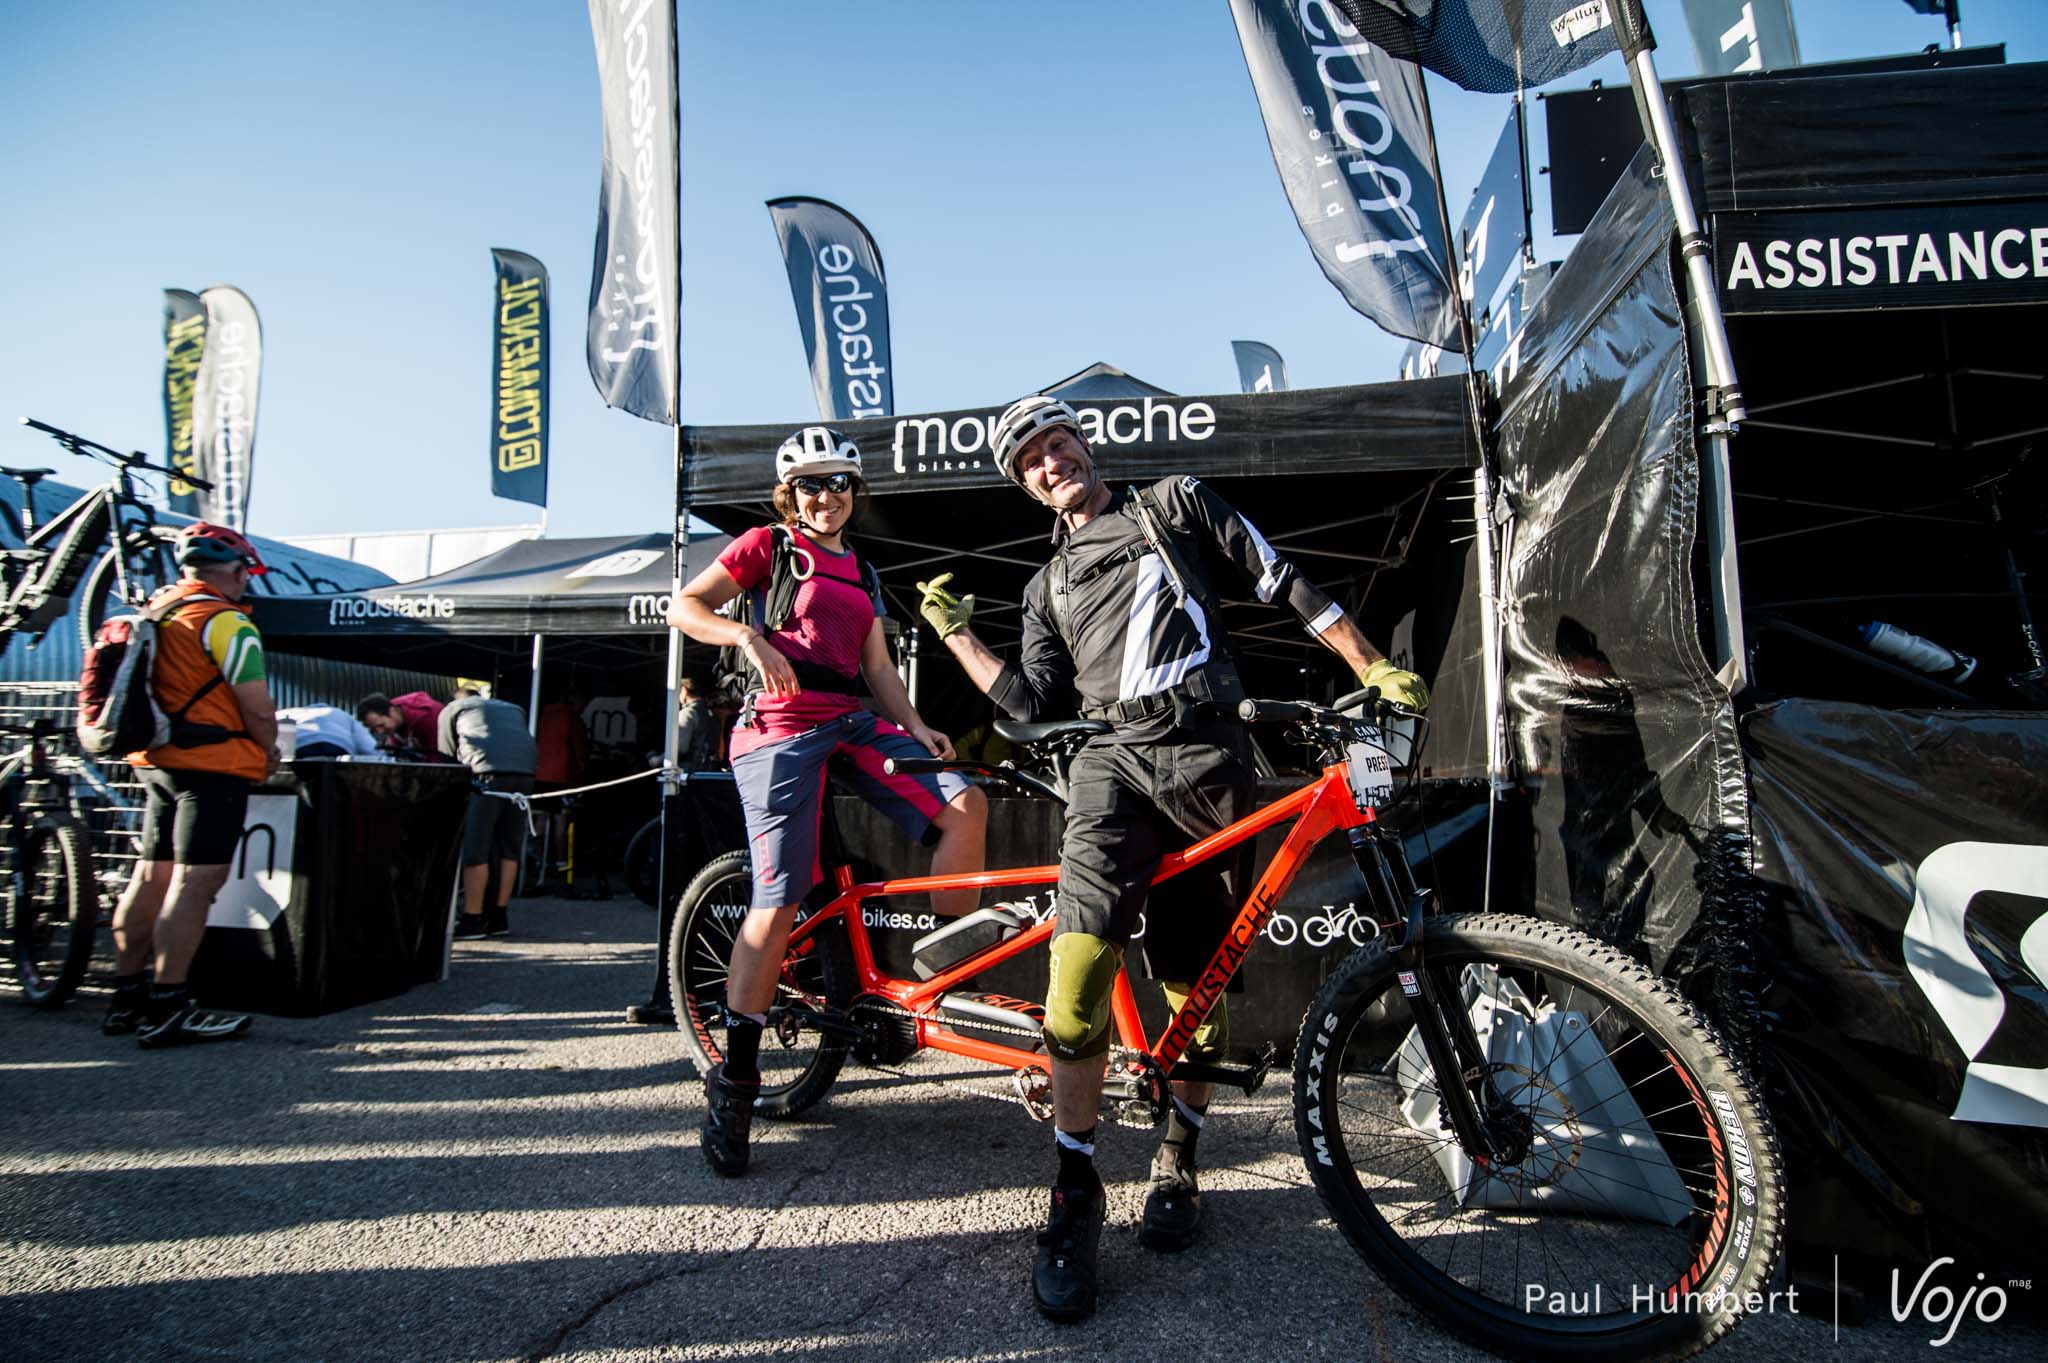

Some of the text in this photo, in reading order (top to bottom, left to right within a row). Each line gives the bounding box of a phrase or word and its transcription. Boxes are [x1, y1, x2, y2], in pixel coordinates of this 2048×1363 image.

[1727, 227, 2048, 291] ASSISTANCE
[892, 397, 1216, 474] moache
[918, 459, 981, 474] bikes
[329, 593, 456, 626] moustache
[1158, 883, 1276, 1068] MOUSTACHE
[1306, 1011, 1339, 1167] MAXXIS
